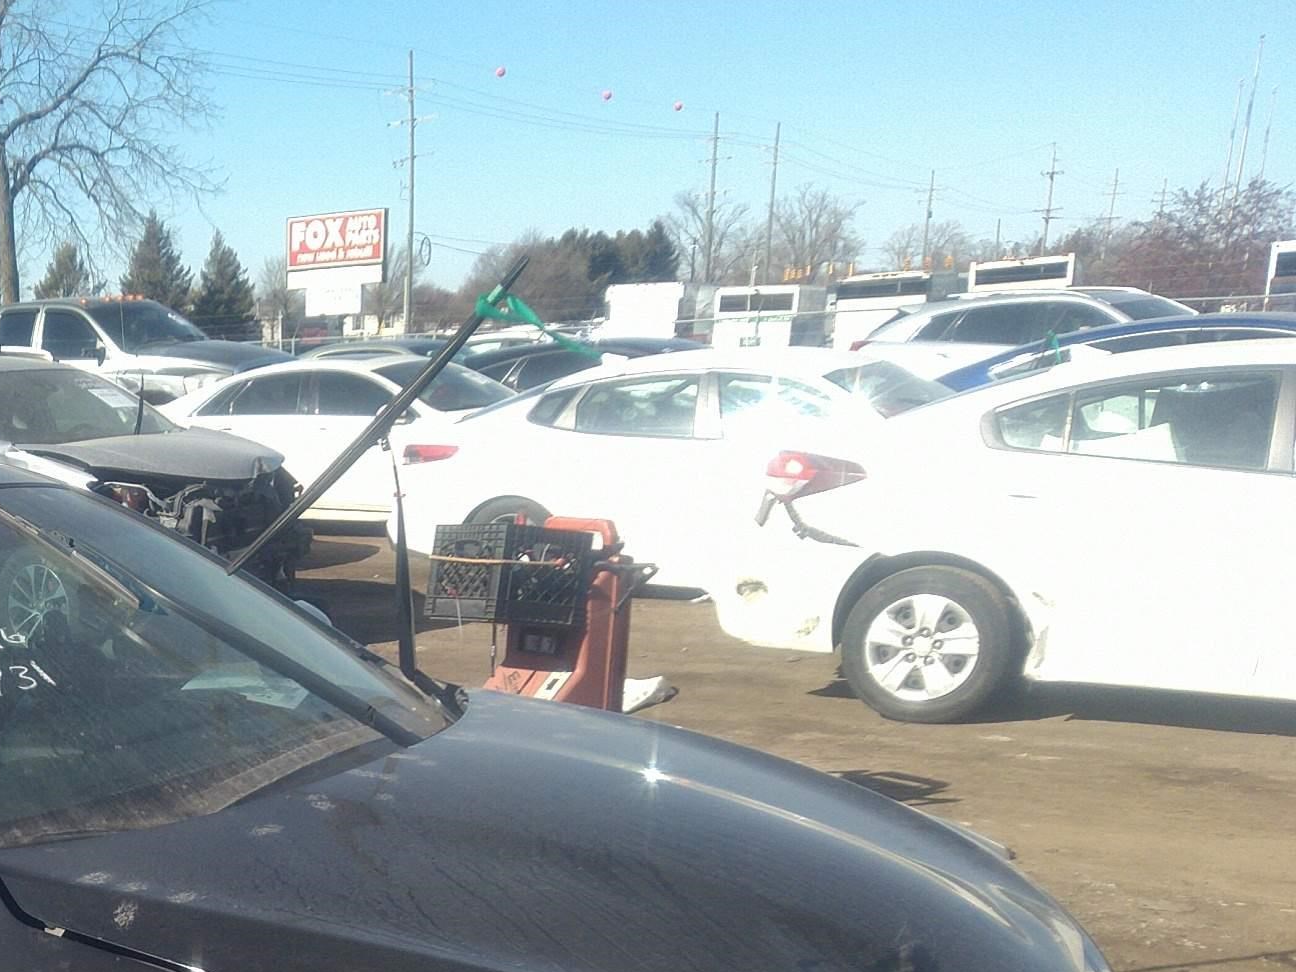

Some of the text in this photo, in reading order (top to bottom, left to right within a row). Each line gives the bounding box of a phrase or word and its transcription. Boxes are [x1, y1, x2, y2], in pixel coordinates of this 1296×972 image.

[348, 214, 377, 230] AUTO
[291, 218, 345, 252] FOX
[345, 228, 380, 246] PARTS
